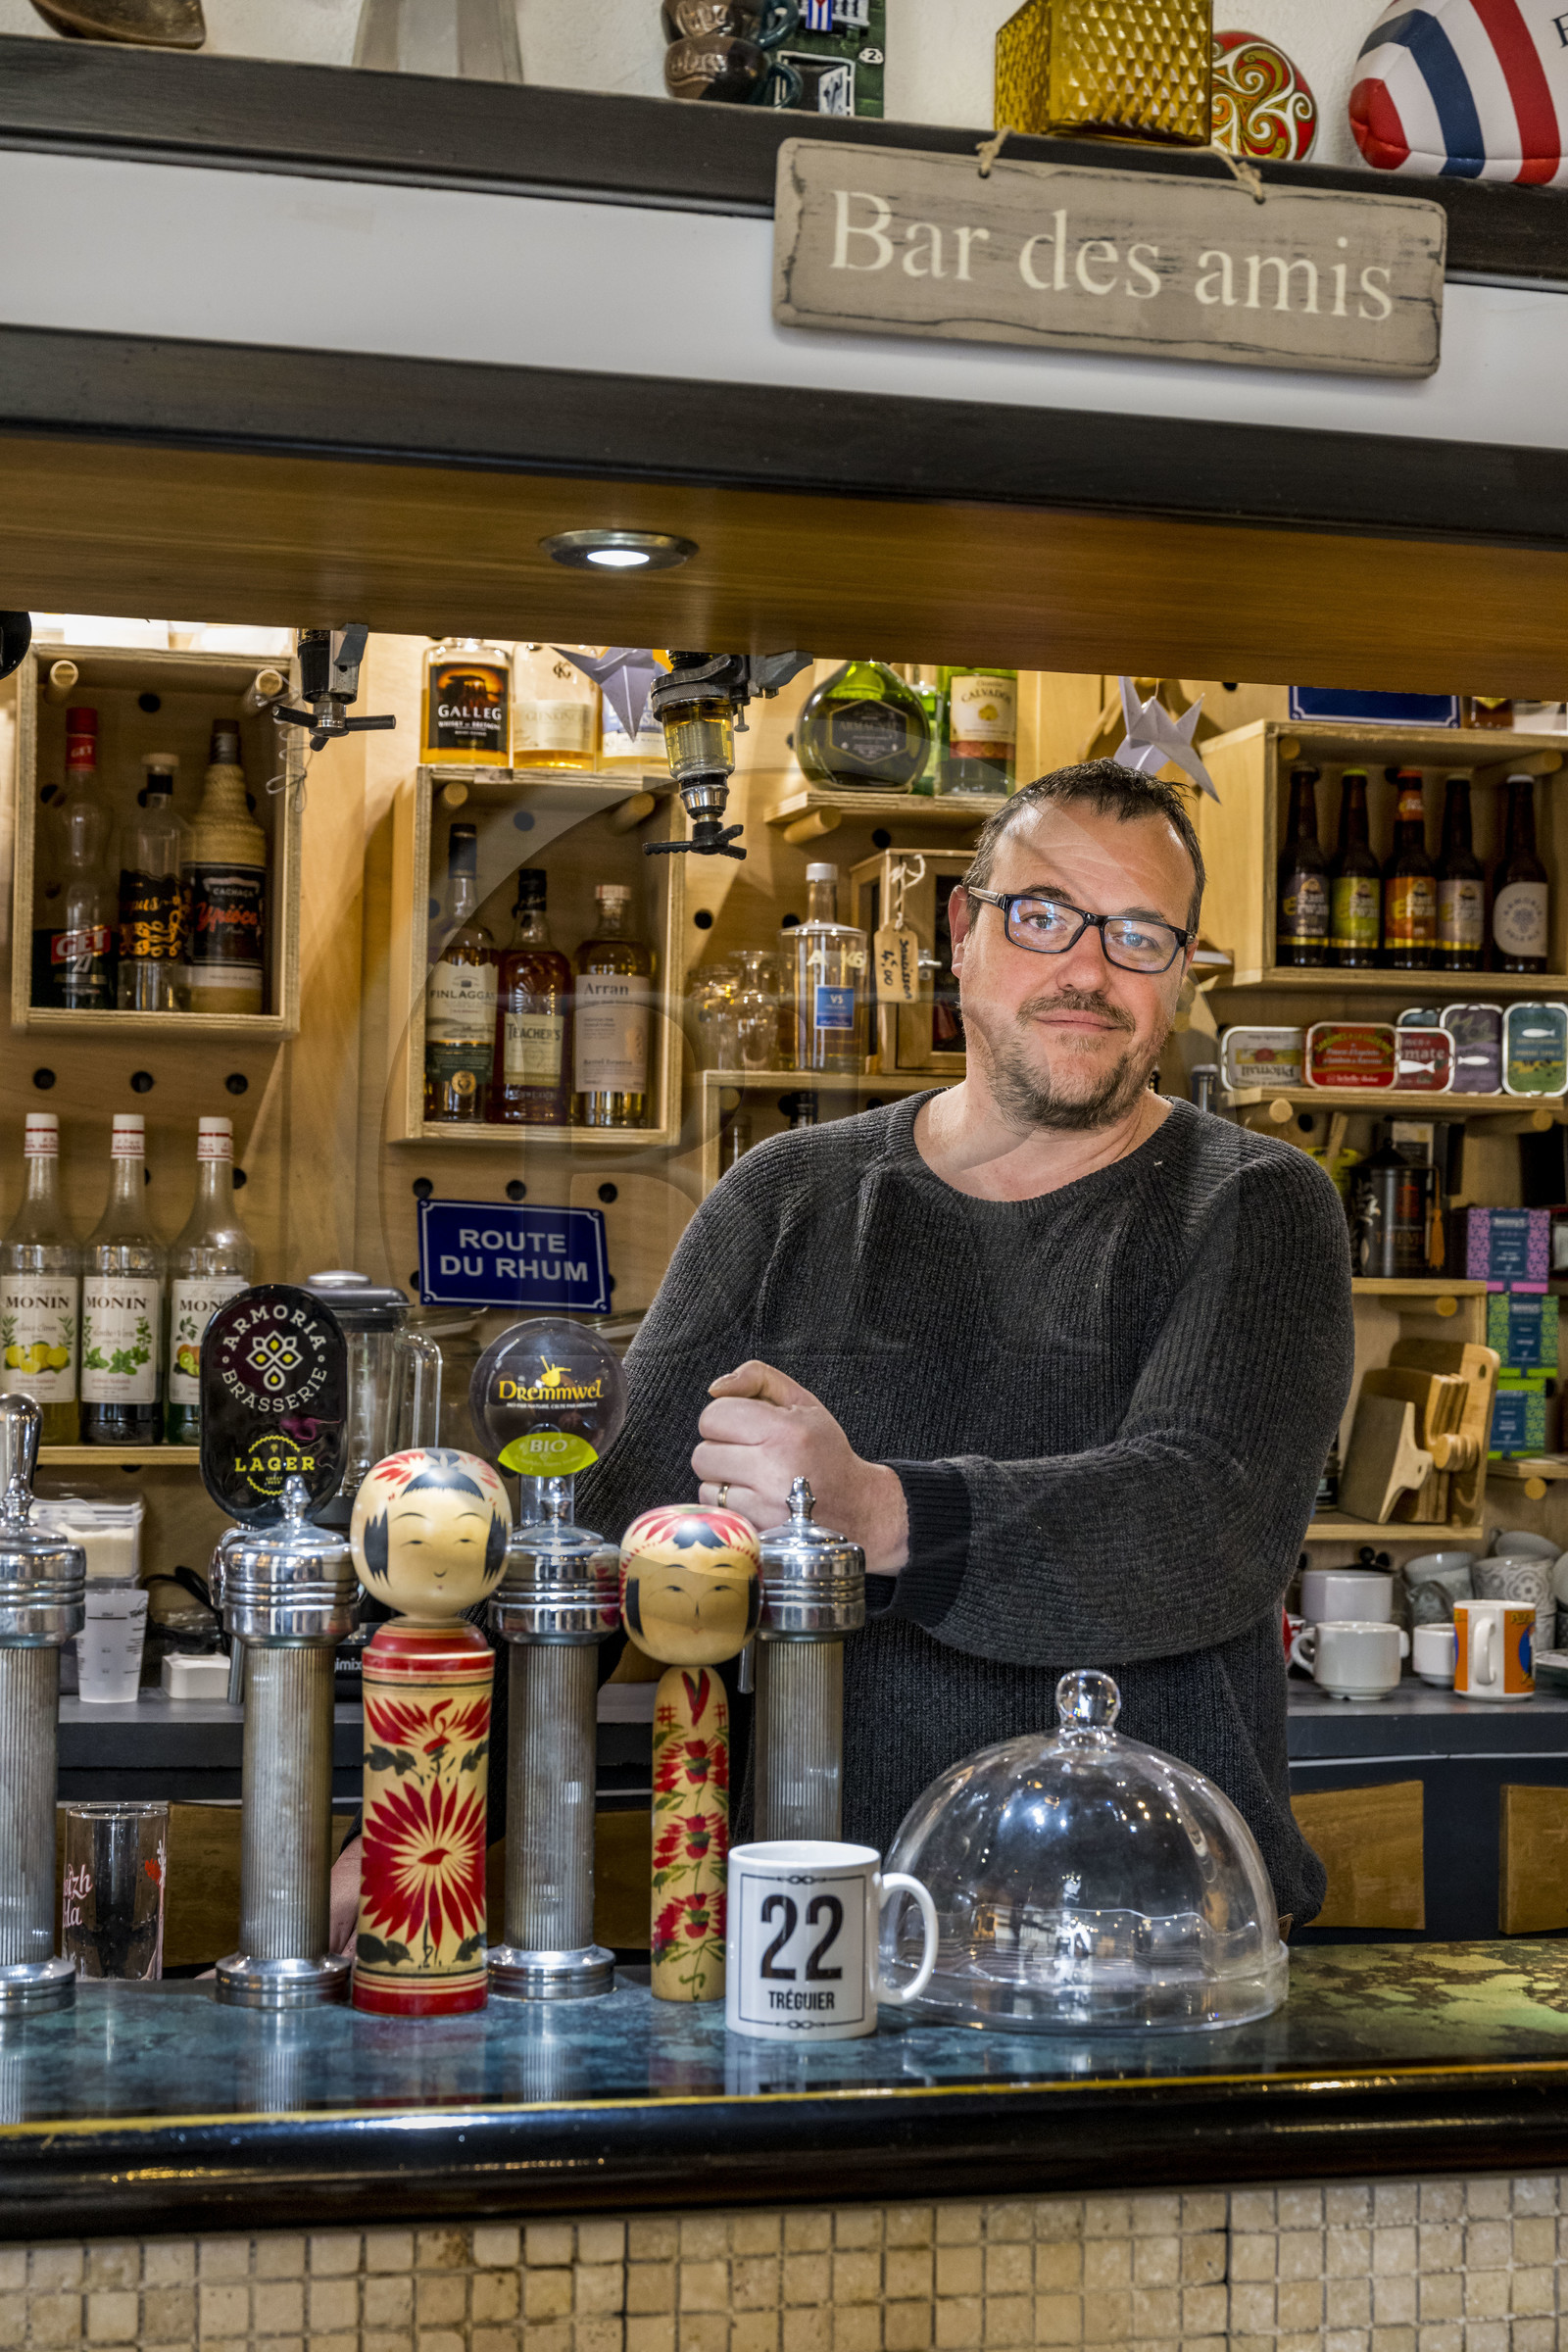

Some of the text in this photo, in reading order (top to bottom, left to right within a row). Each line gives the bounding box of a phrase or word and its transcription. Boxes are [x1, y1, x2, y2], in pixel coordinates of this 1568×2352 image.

[866, 49, 877, 61] 2
[830, 190, 1394, 321] Bar des amis
[437, 704, 502, 721] GALLEG
[56, 929, 108, 957] GET
[72, 953, 93, 973] 27
[583, 982, 630, 997] Arran
[830, 994, 844, 1004] VS
[459, 1228, 567, 1254] ROUTE
[440, 1254, 589, 1283] DU RHUM
[6, 1296, 70, 1309] MONIN
[86, 1296, 147, 1310] MONIN
[223, 1304, 326, 1351] ARMORIA
[221, 1368, 327, 1412] BRASSERIE
[499, 1379, 604, 1401] Dremmwel
[530, 1439, 568, 1452] BIO
[234, 1456, 316, 1472] LAGER
[760, 1893, 845, 1981] 22
[768, 1988, 835, 2011] TRÉGUIER
